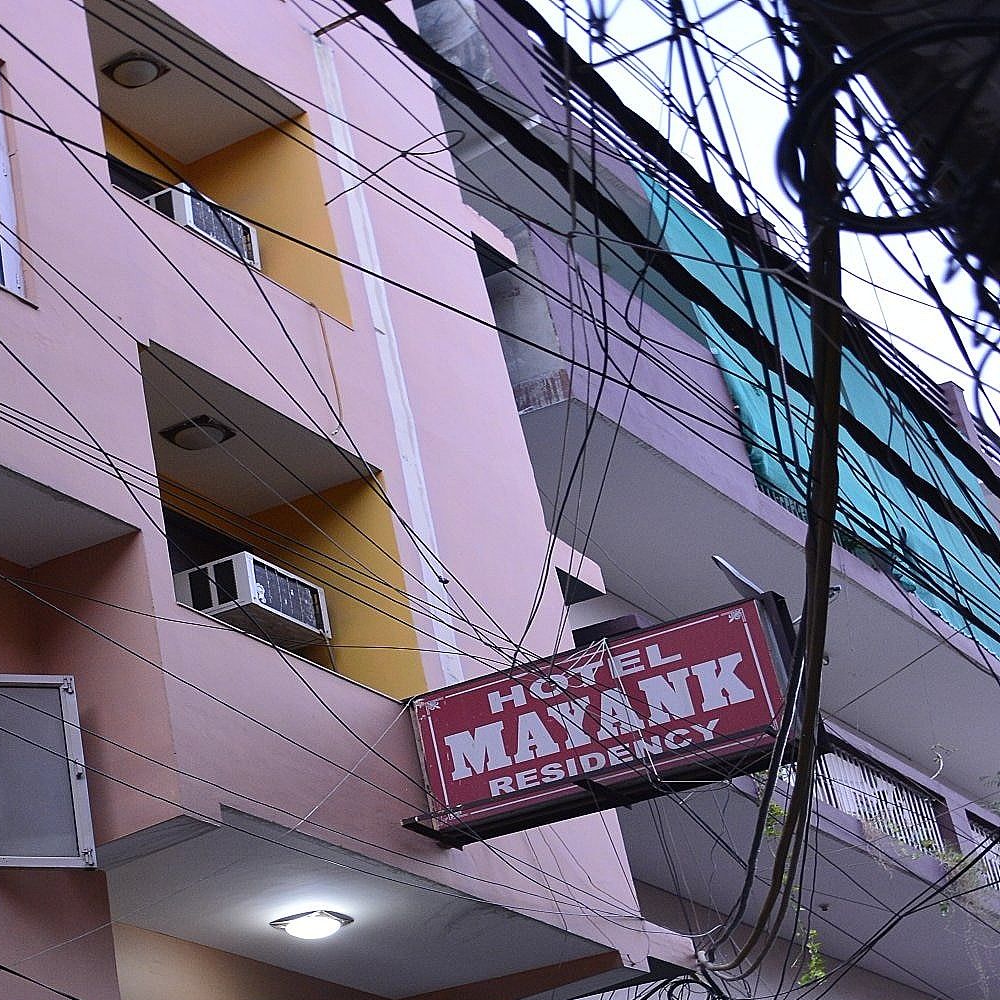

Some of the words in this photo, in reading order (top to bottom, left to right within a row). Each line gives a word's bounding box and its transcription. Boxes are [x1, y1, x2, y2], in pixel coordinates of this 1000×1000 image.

[444, 652, 755, 781] MAYANK
[488, 644, 682, 714] HOTEL
[488, 719, 721, 797] RESIDENCY
